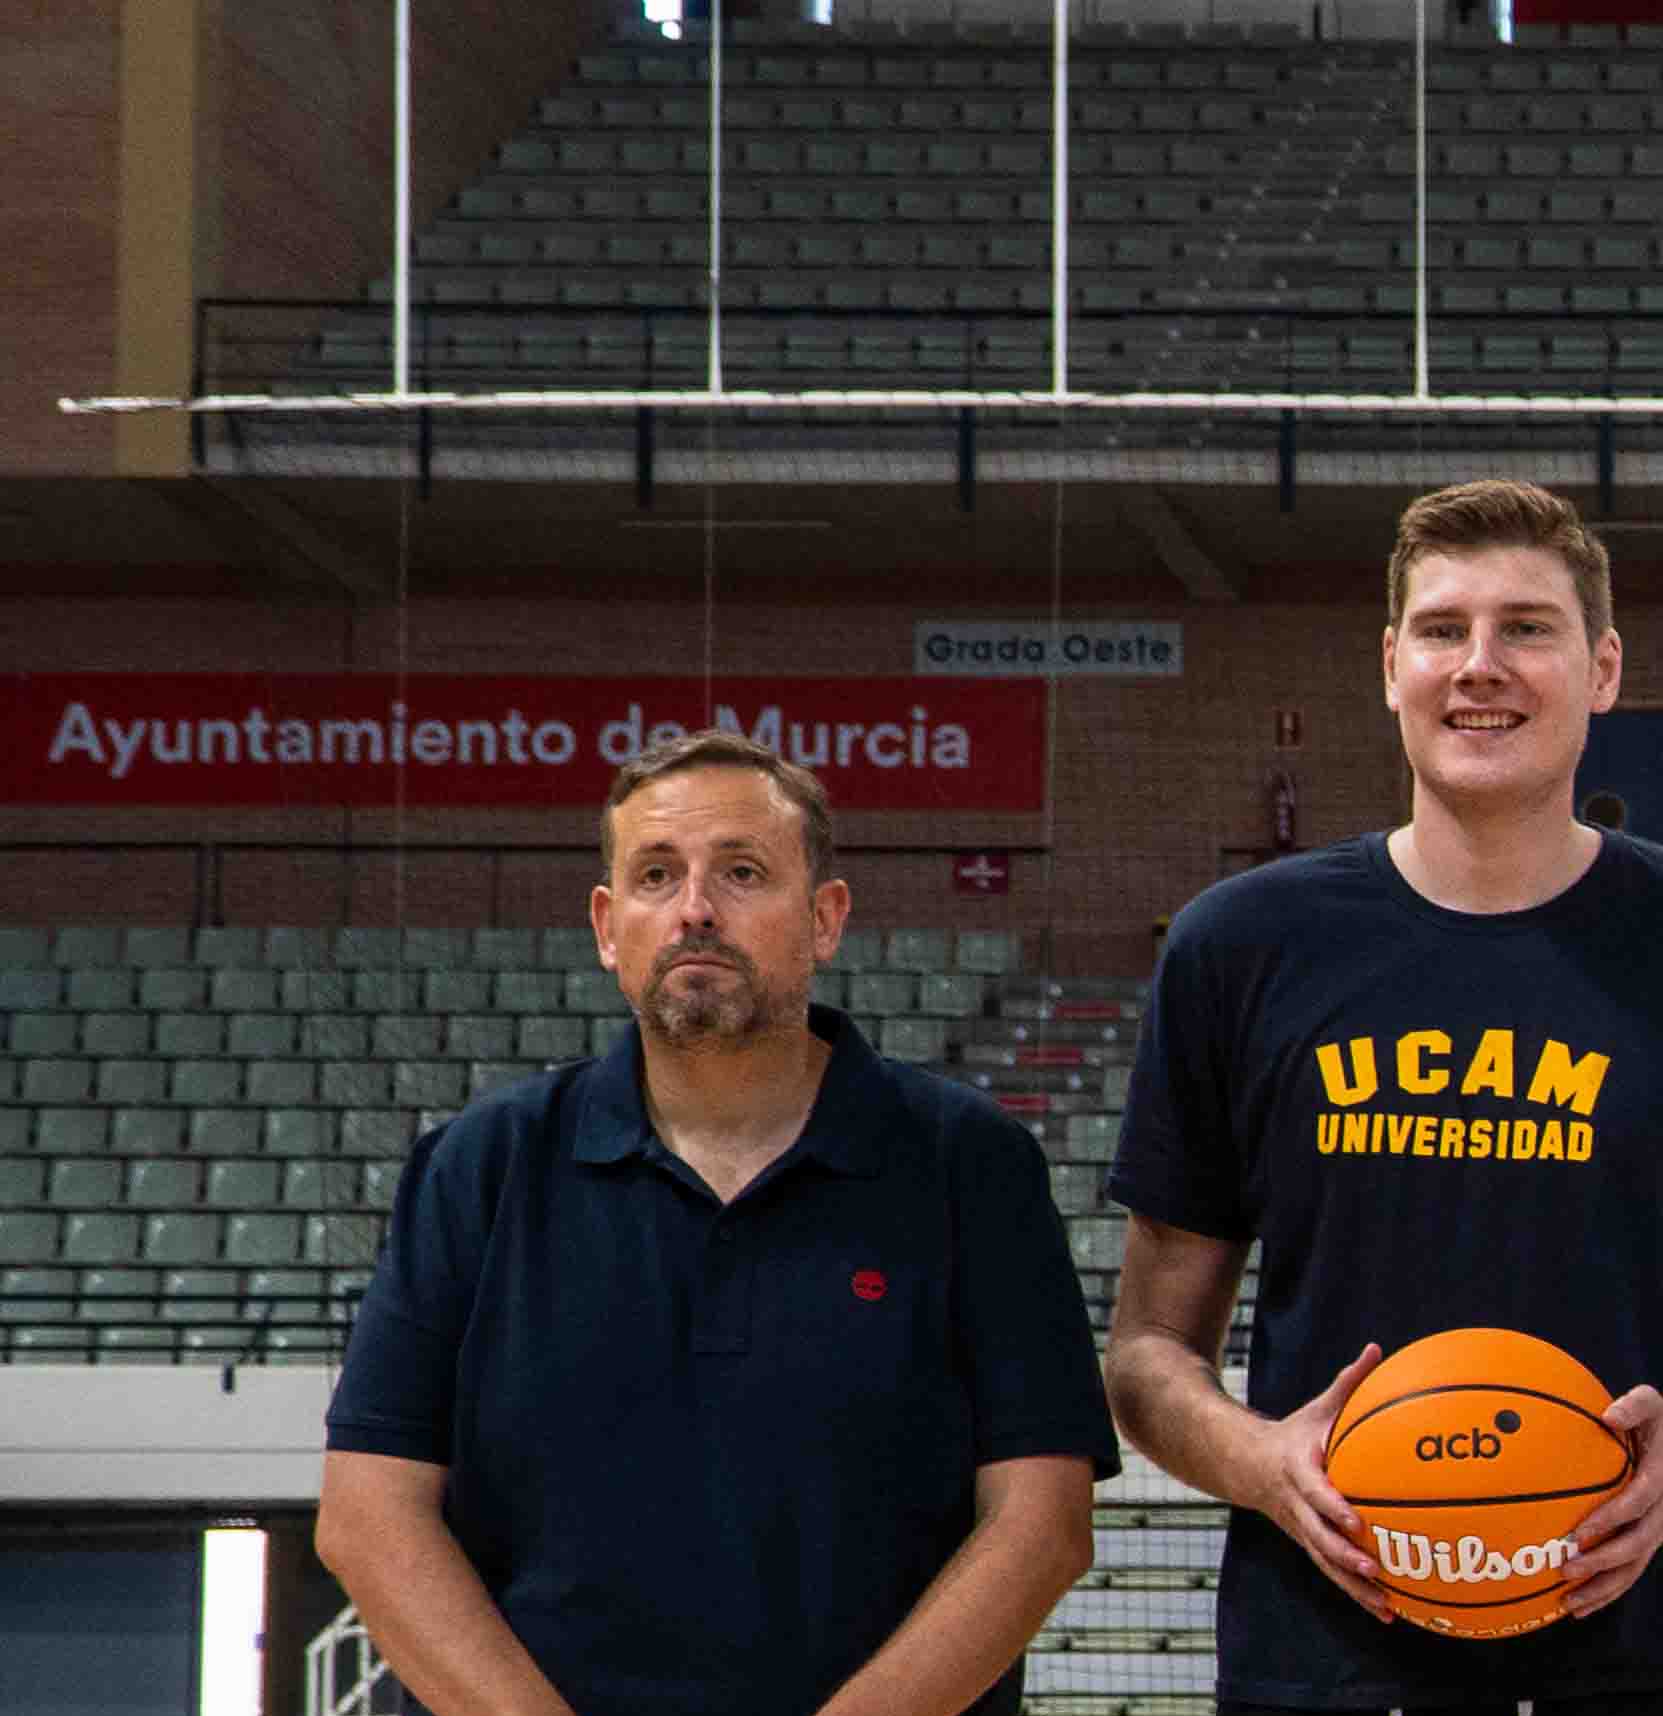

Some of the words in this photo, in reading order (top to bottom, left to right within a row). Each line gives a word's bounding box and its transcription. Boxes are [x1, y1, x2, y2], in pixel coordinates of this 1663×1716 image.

[926, 634, 1044, 663] Grada
[1063, 634, 1170, 663] Oeste
[48, 702, 577, 779] Ayuntamiento
[715, 704, 971, 769] Murcia
[1314, 1028, 1612, 1117] UCAM
[1316, 1111, 1596, 1162] UNIVERSIDAD
[1414, 1427, 1502, 1462] acb
[1371, 1525, 1579, 1584] Wilson
